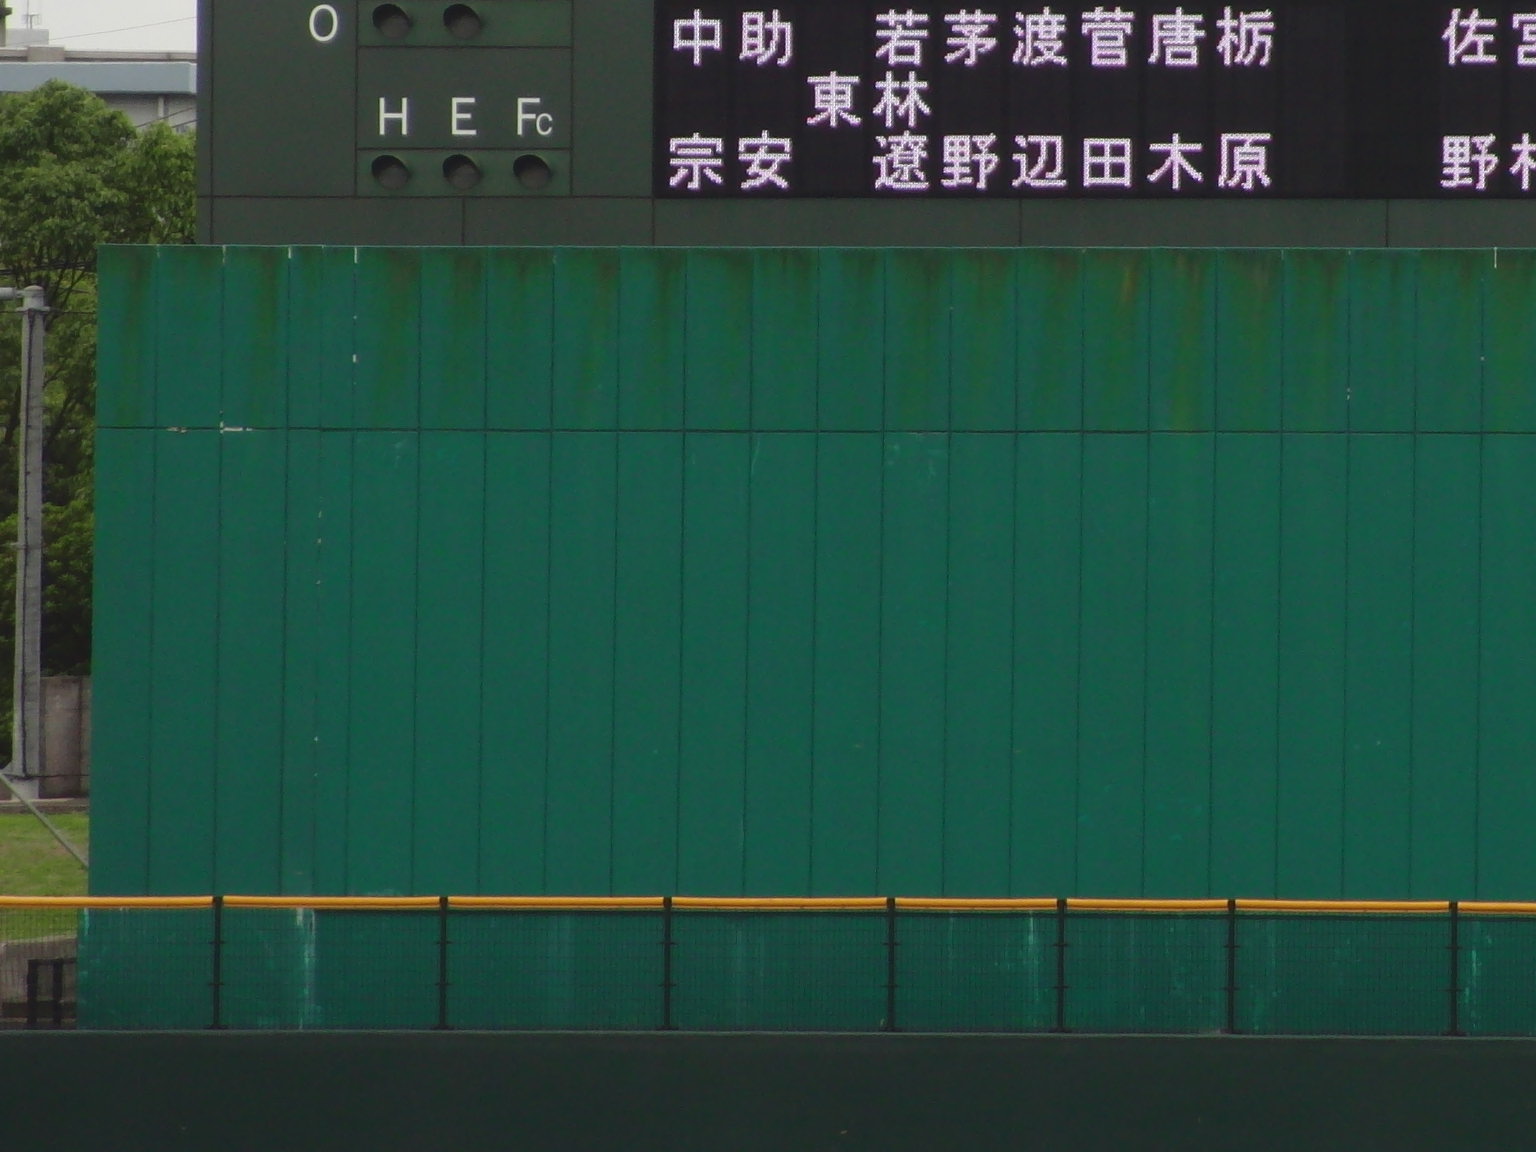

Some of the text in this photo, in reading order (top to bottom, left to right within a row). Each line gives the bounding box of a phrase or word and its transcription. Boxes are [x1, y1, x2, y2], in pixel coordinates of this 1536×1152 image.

[309, 4, 339, 42] O
[379, 97, 408, 136] H
[451, 97, 477, 136] E
[806, 70, 862, 127] 東
